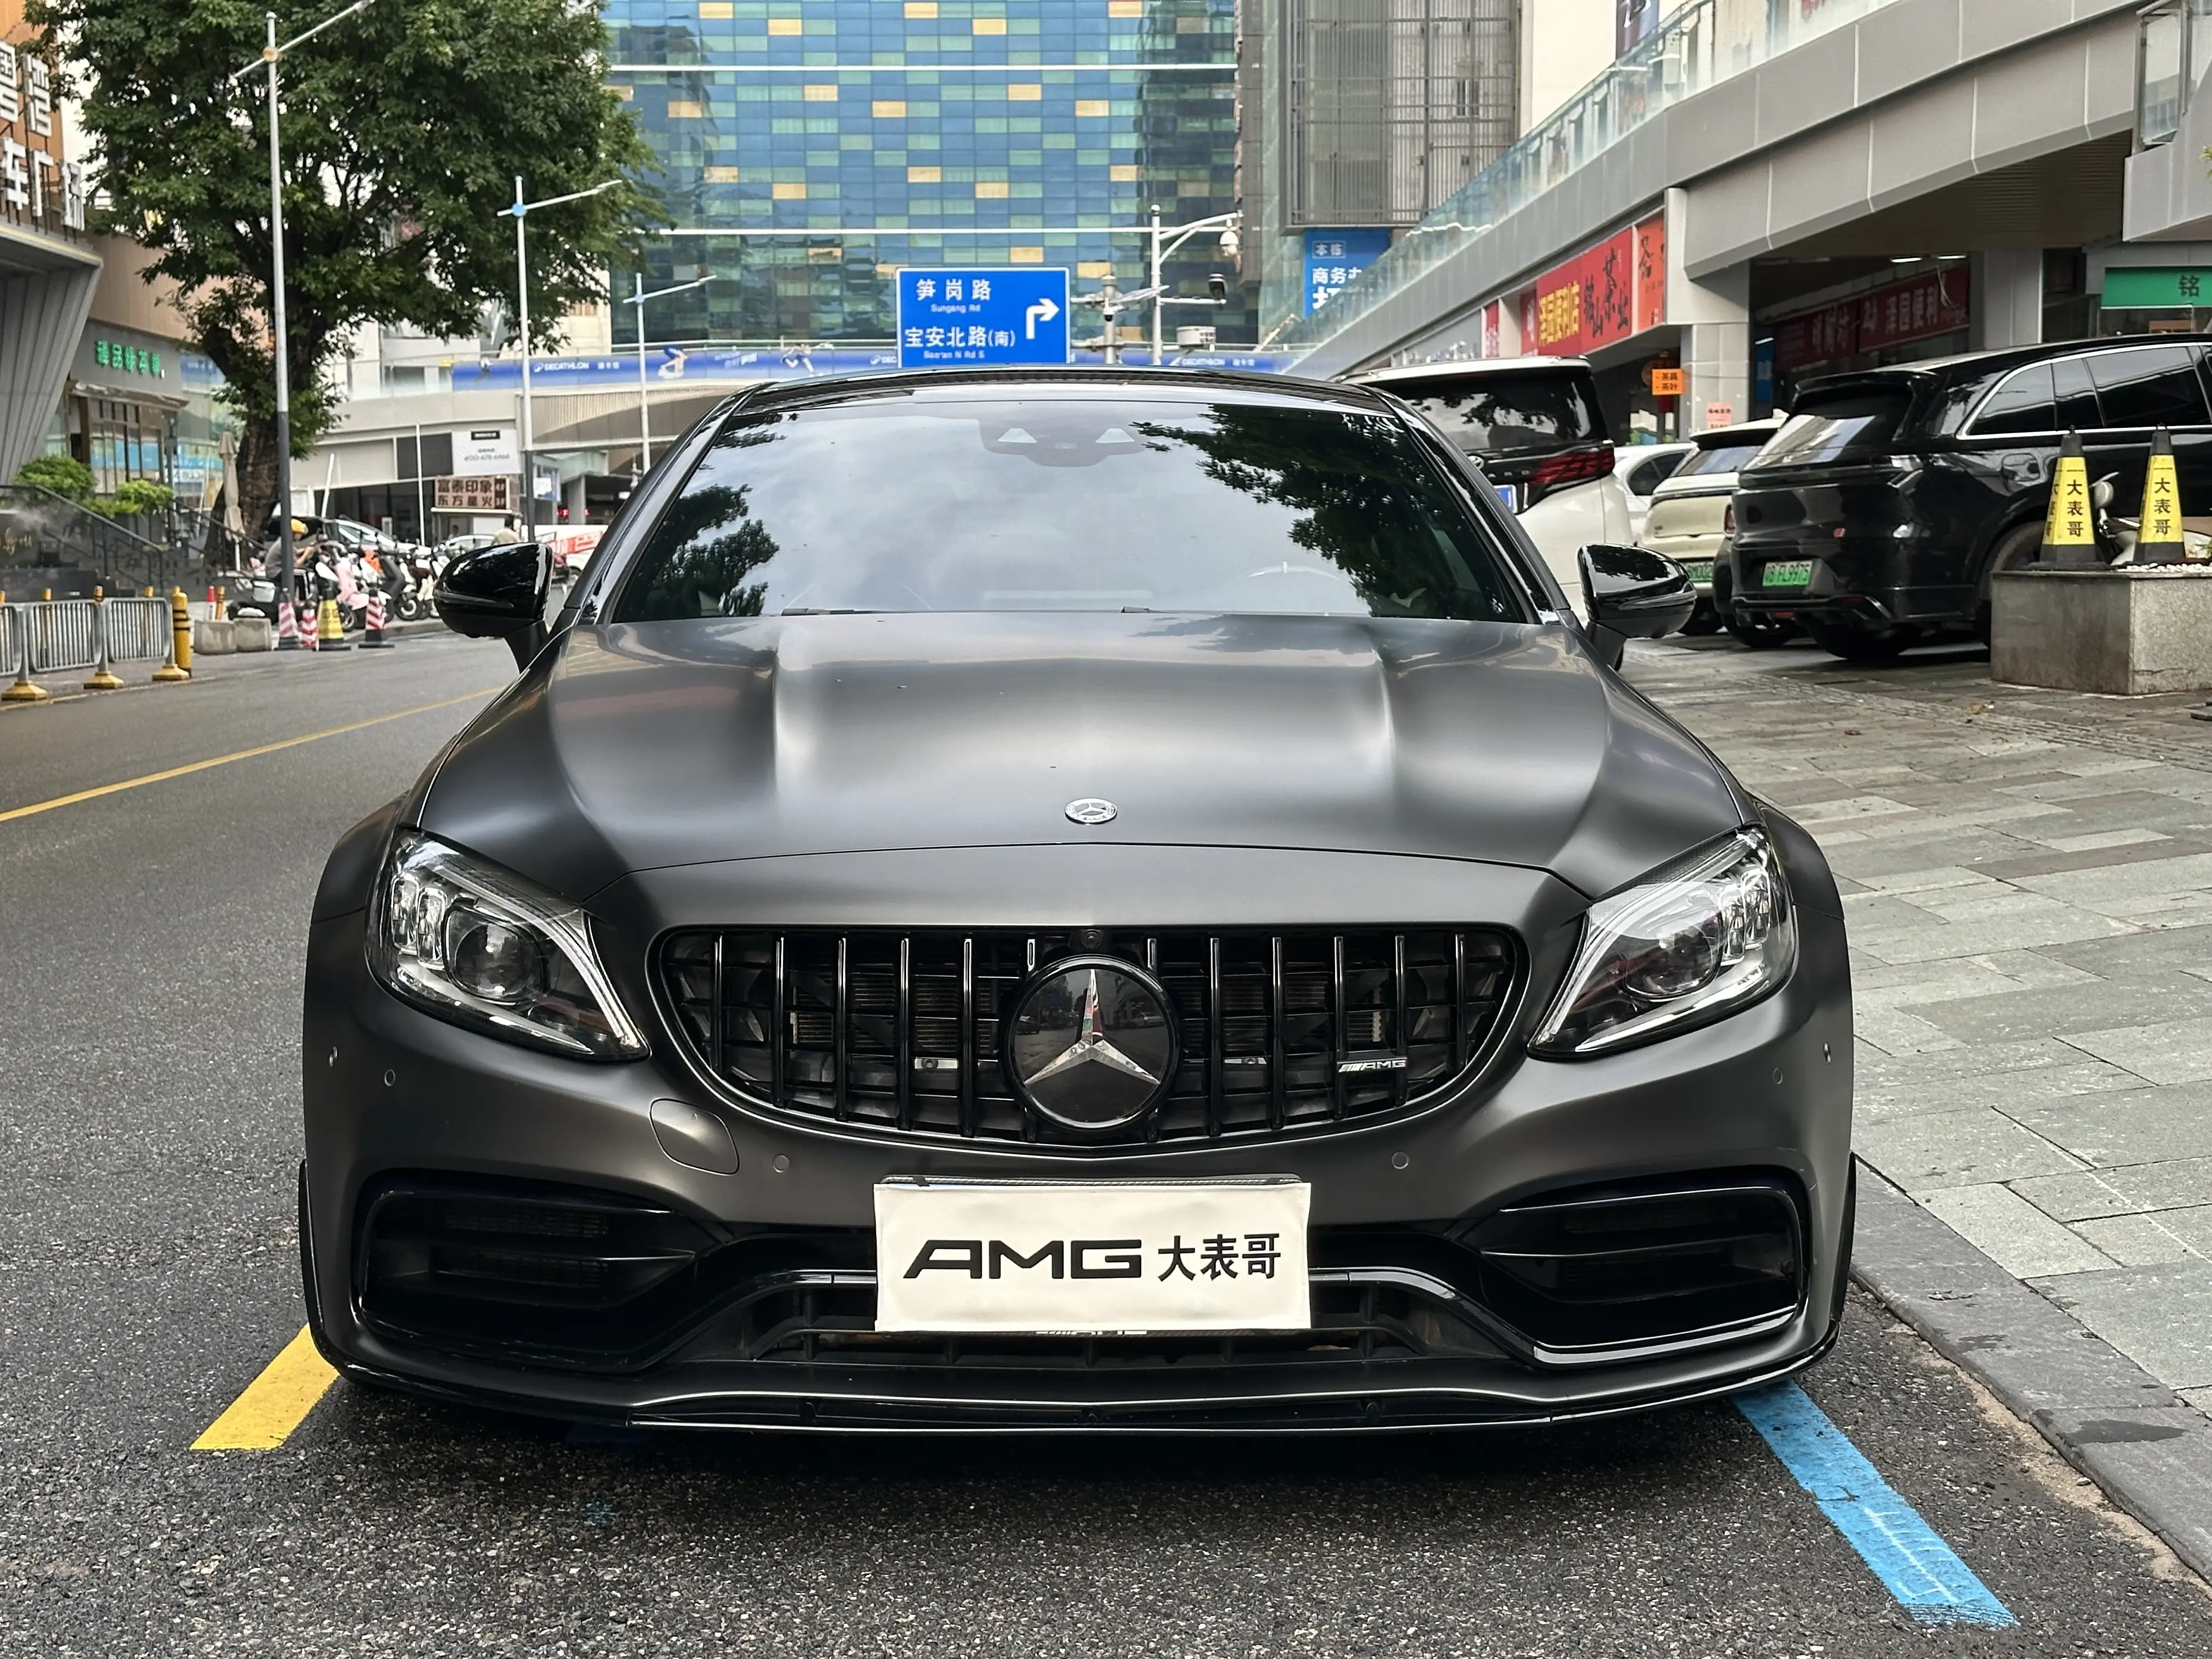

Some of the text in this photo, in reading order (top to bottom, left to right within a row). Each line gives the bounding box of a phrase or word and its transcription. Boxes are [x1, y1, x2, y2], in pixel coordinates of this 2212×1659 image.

[916, 278, 992, 301] 笋岗路
[2177, 274, 2200, 298] 铭
[930, 304, 981, 314] Sungang Rd
[904, 325, 1016, 348] 宝安北路(南)
[964, 350, 977, 358] Rd
[2067, 479, 2085, 537] 大表哥
[2154, 477, 2172, 536] 大表哥
[1360, 1060, 1406, 1071] AMG
[903, 1233, 1282, 1282] AMG 大表哥
